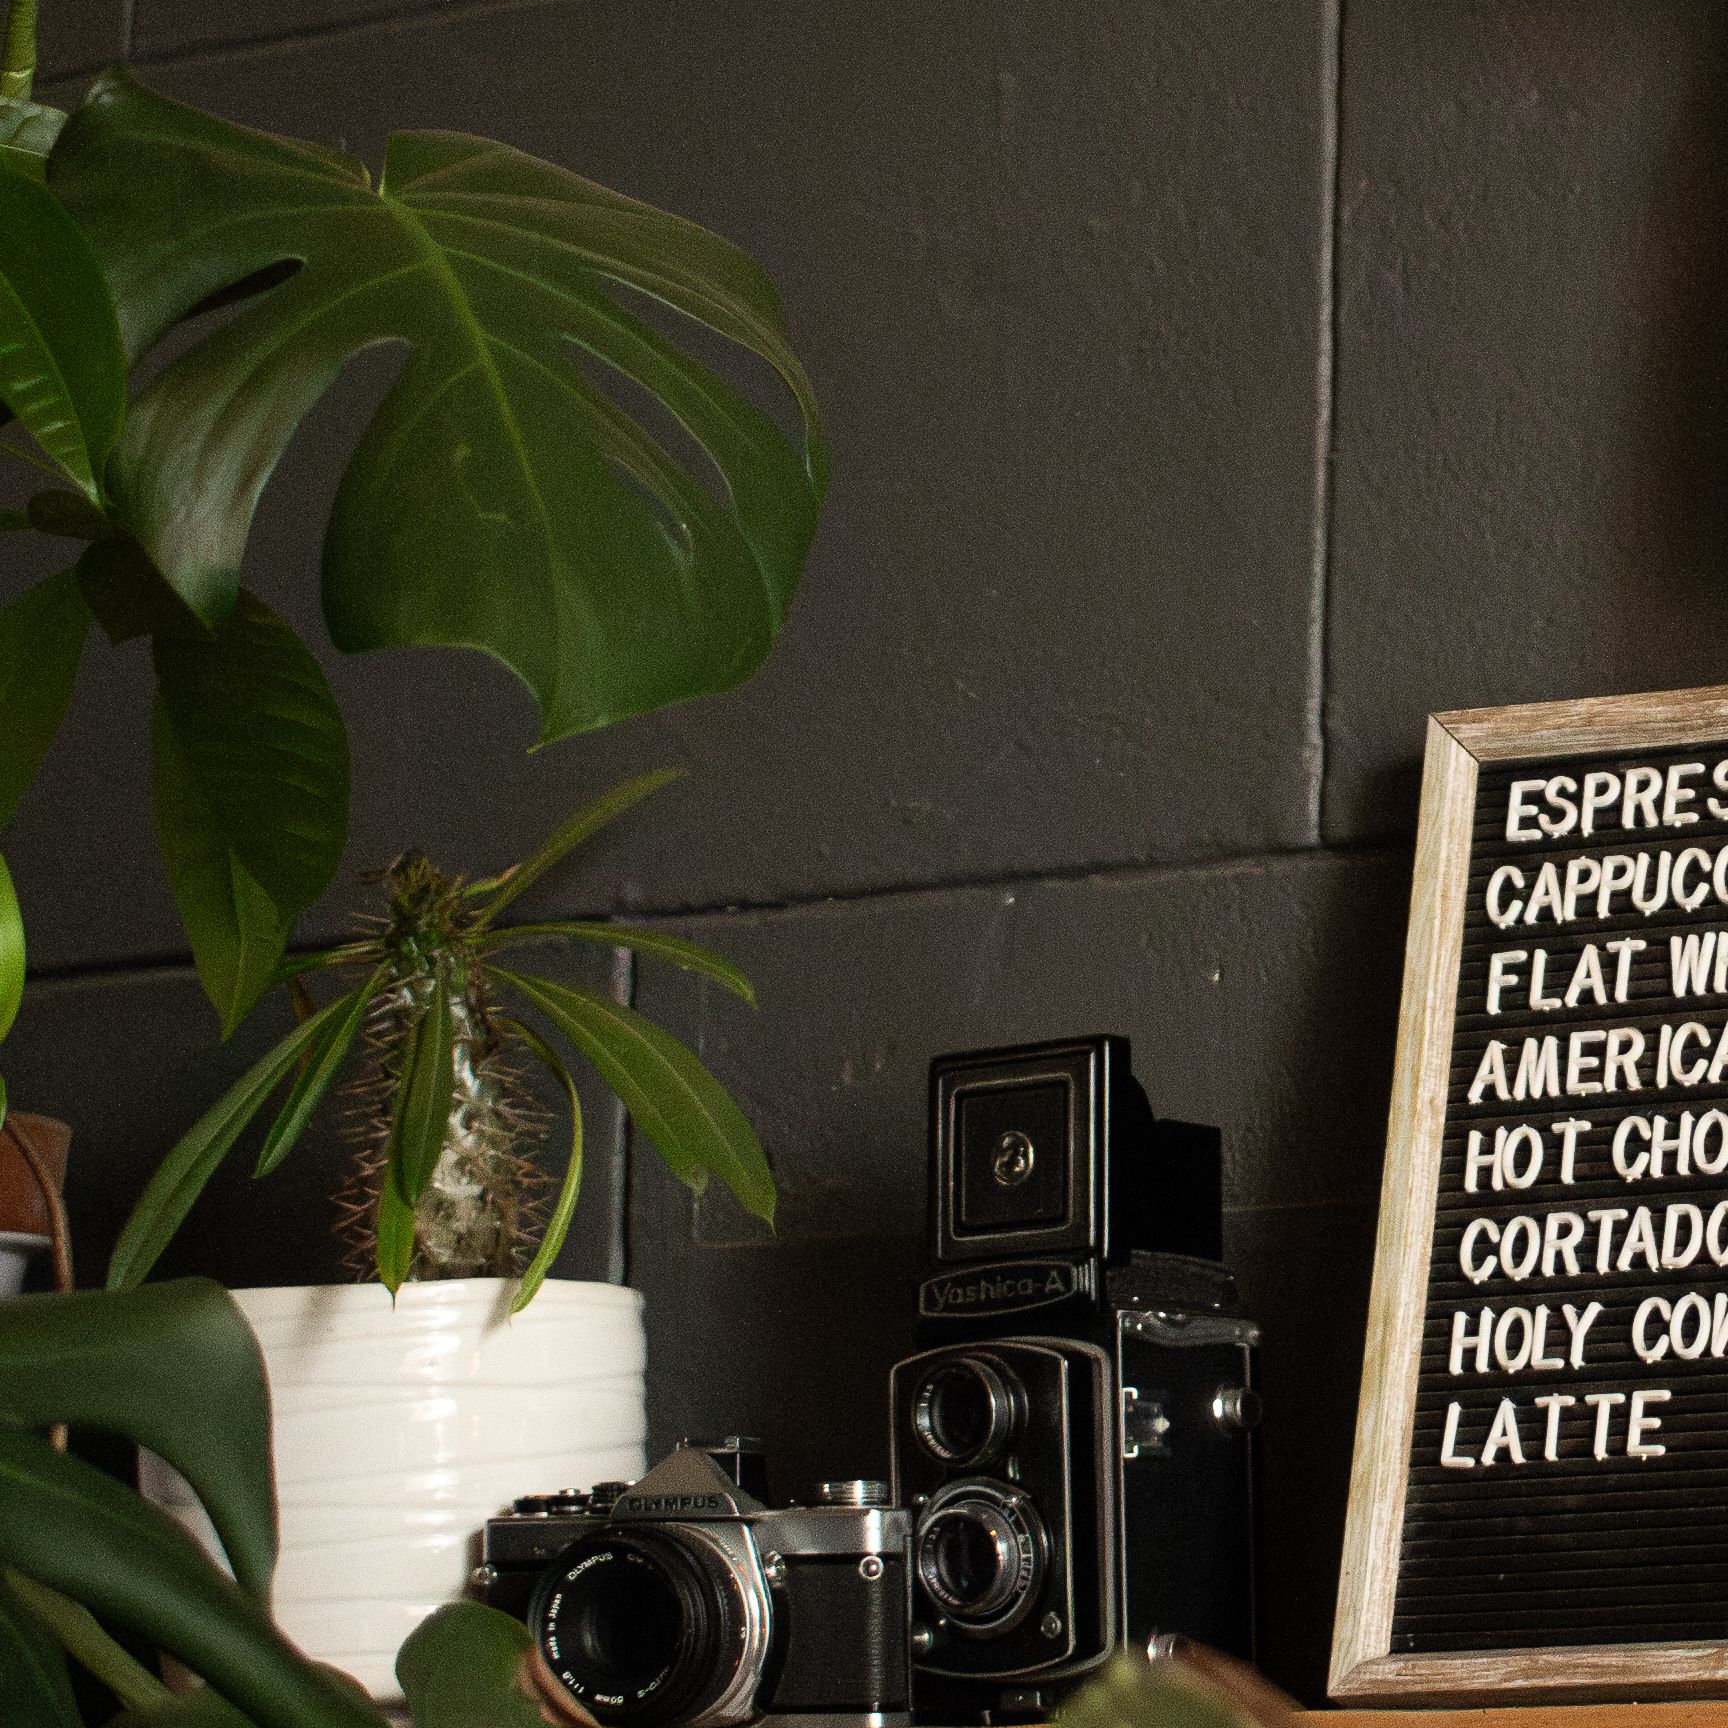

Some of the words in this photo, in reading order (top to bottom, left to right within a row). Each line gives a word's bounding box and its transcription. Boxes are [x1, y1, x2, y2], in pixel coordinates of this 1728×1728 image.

[1487, 936, 1648, 1015] FLAT
[1464, 1116, 1593, 1193] HOT
[931, 1268, 1067, 1312] Yashica-A
[1448, 1301, 1605, 1375] HOLY
[1440, 1388, 1672, 1469] LATTE
[628, 1494, 719, 1512] OLYMPUS
[566, 1551, 614, 1581] OLYMPUS
